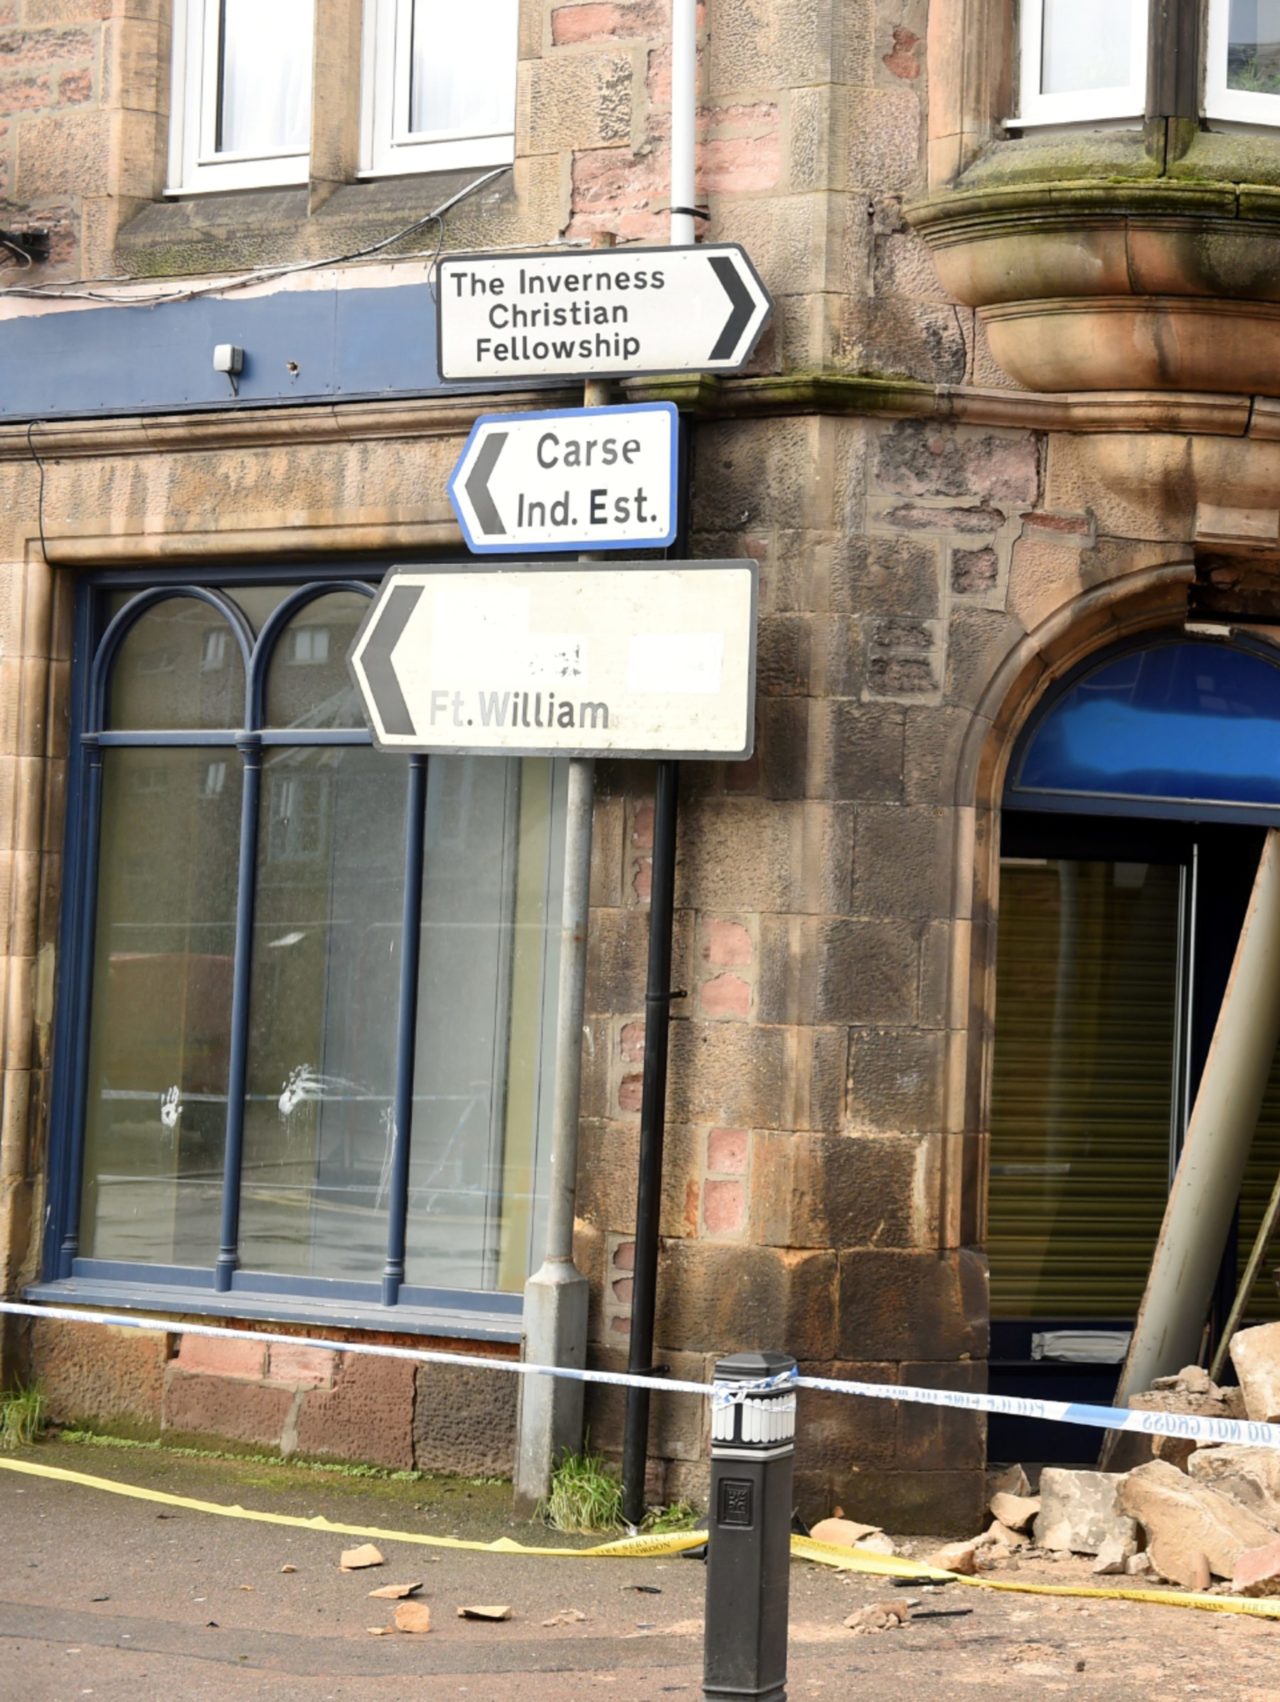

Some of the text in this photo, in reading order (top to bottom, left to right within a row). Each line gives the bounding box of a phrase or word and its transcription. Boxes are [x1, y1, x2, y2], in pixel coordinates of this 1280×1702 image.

[450, 268, 665, 298] The Inverness
[488, 301, 628, 330] Christian
[476, 332, 641, 363] Fellowship
[536, 432, 641, 470] Carse
[516, 487, 657, 528] Ind. Est.
